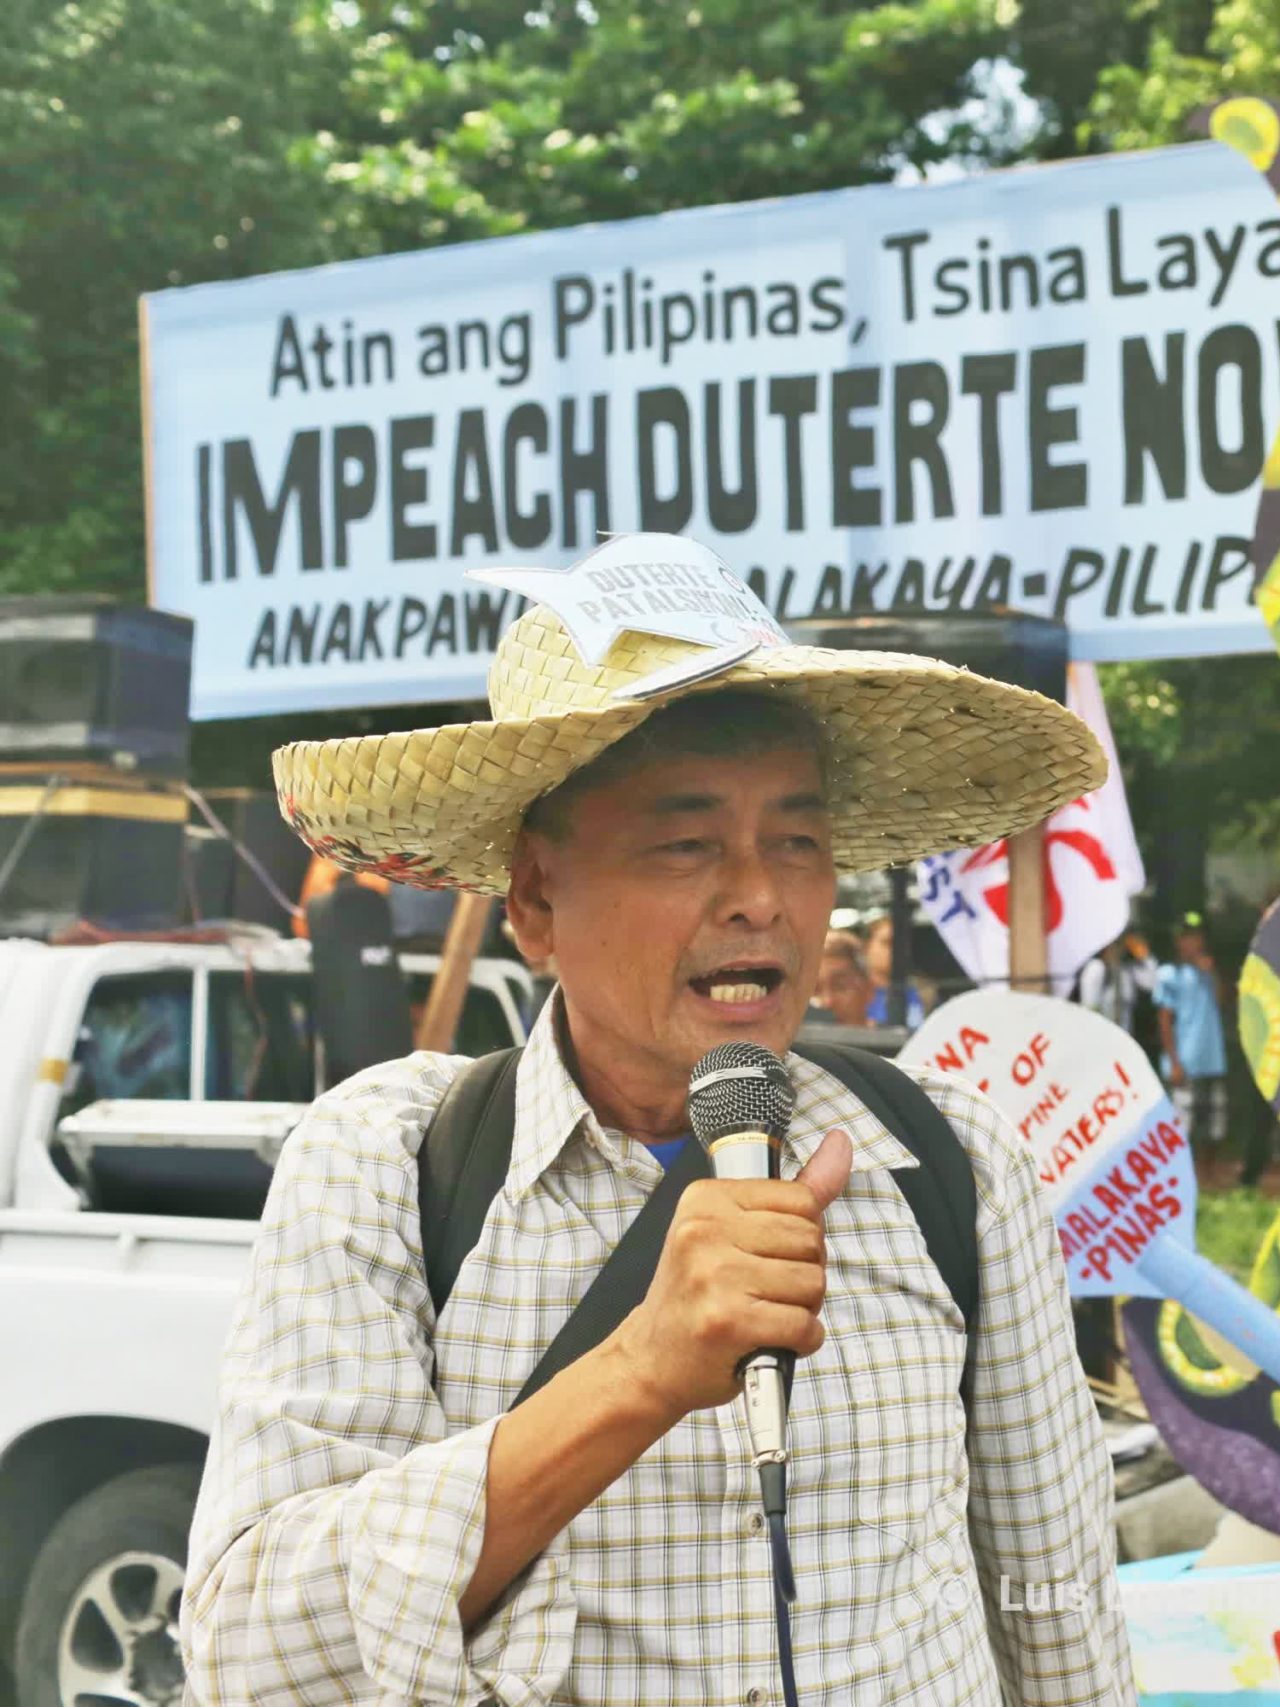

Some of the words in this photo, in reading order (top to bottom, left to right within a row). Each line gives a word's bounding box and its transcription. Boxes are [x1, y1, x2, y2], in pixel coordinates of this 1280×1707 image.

[270, 312, 394, 398] Atin
[417, 311, 533, 386] ang
[552, 268, 868, 366] Pilipinas,
[883, 231, 1087, 323] Tsina
[195, 393, 613, 585] IMPEACH
[636, 341, 1089, 534] DUTERTE
[586, 562, 718, 593] DUTERTE
[926, 1026, 991, 1073] NA
[1010, 1031, 1051, 1086] OF
